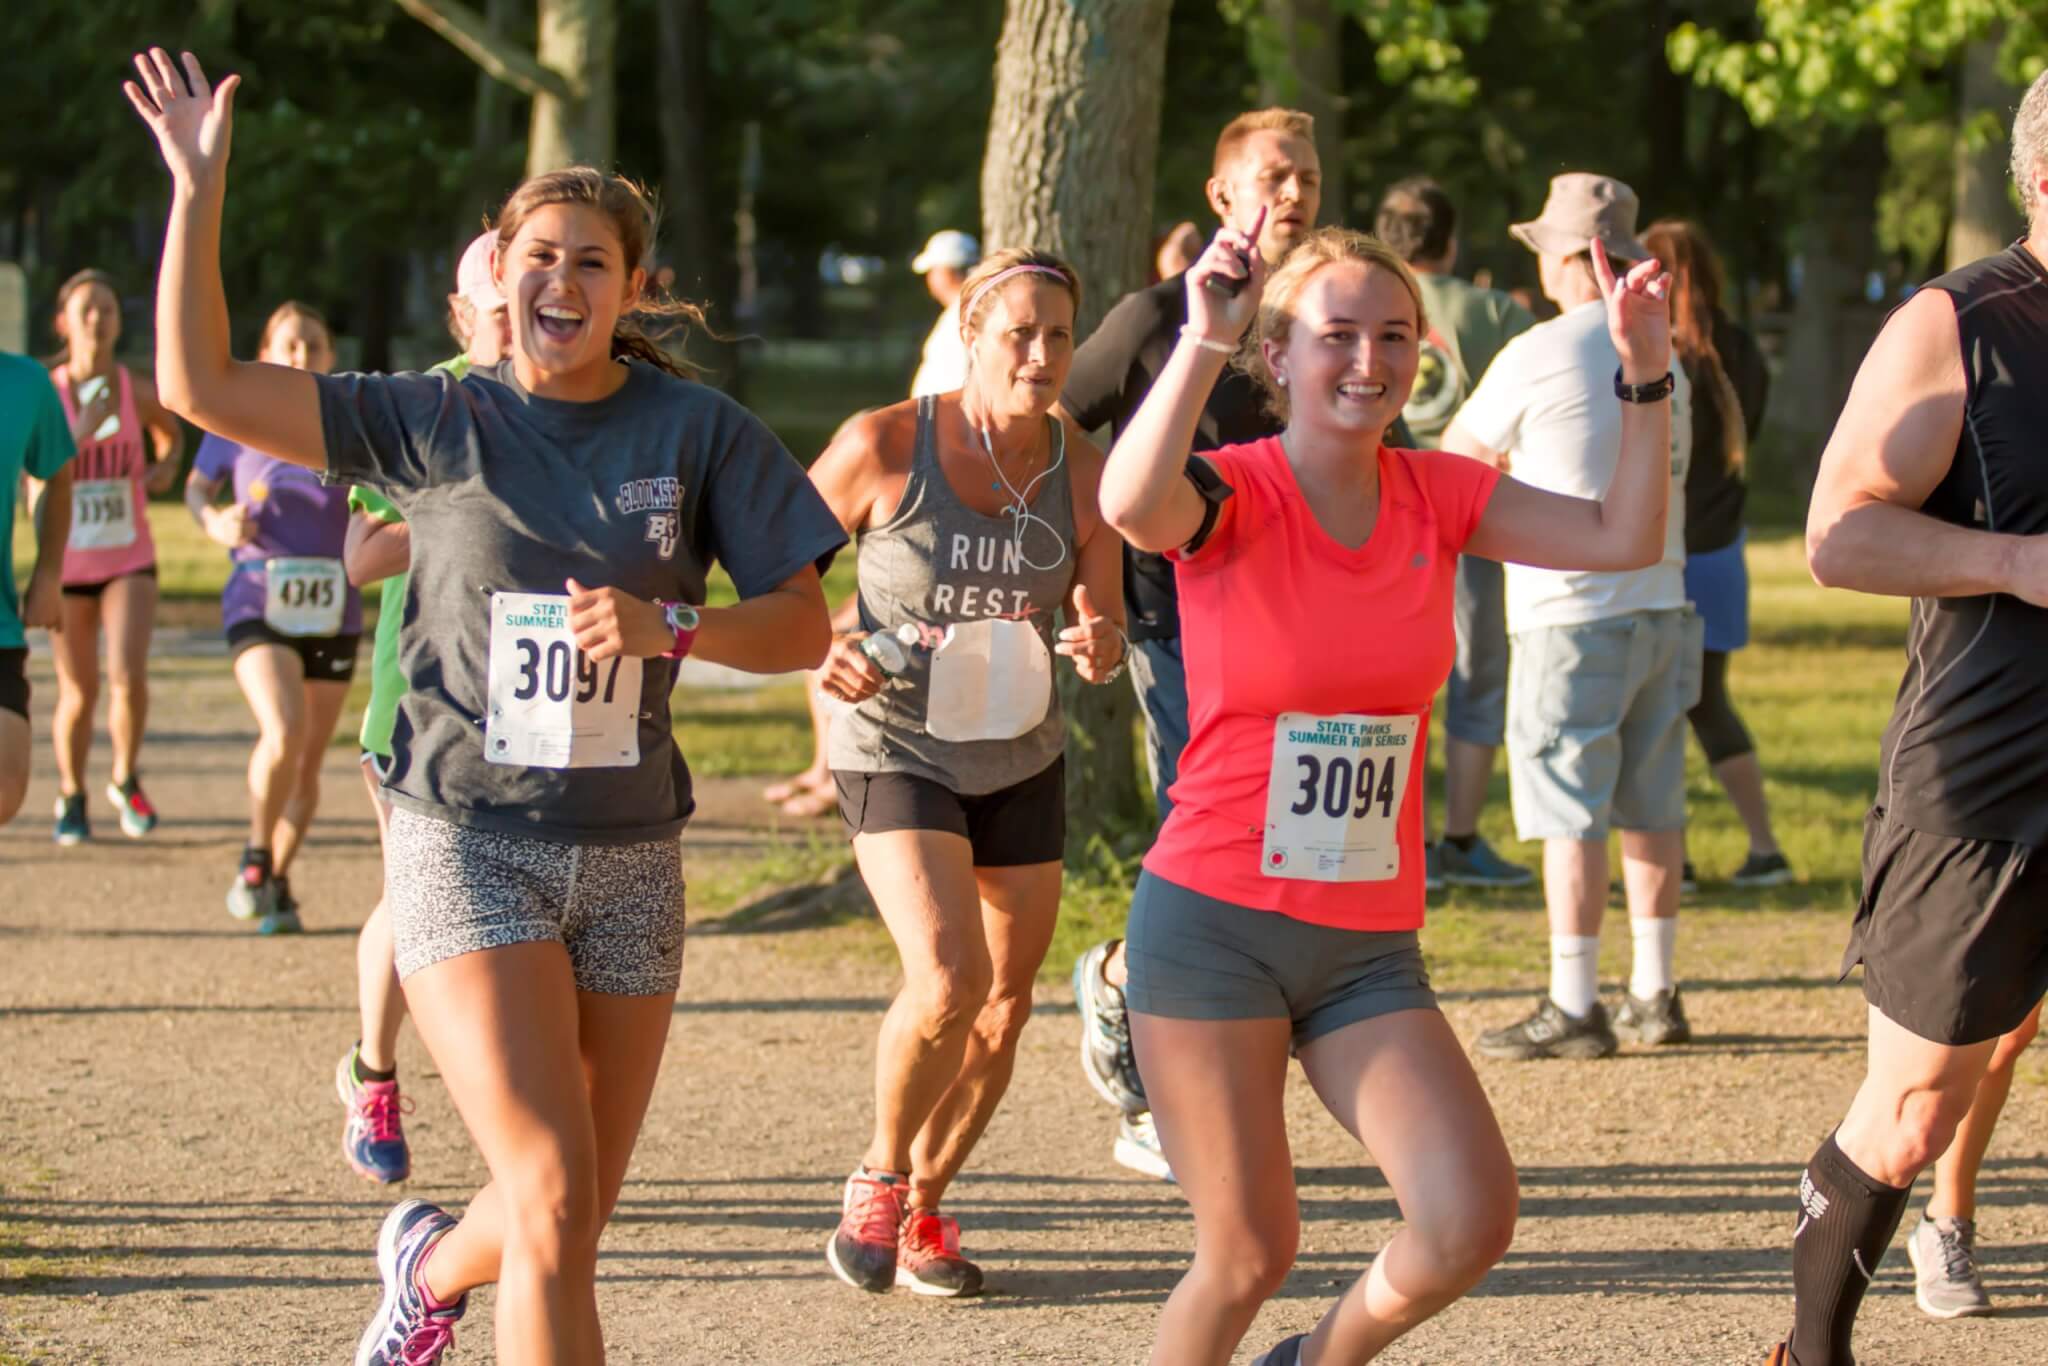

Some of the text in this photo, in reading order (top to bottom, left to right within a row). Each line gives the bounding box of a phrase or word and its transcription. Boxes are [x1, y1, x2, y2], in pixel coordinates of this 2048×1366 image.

[620, 477, 685, 515] BLOOMSB
[950, 533, 1023, 575] RUN
[280, 578, 335, 608] 4345
[933, 583, 1029, 619] REST
[505, 614, 565, 629] SUMMER
[533, 603, 568, 617] STAT
[513, 637, 623, 704] 3097
[1288, 731, 1408, 749] SUMMER RUN SERIES
[1316, 720, 1392, 736] STATE PARKS
[1290, 754, 1396, 819] 3094
